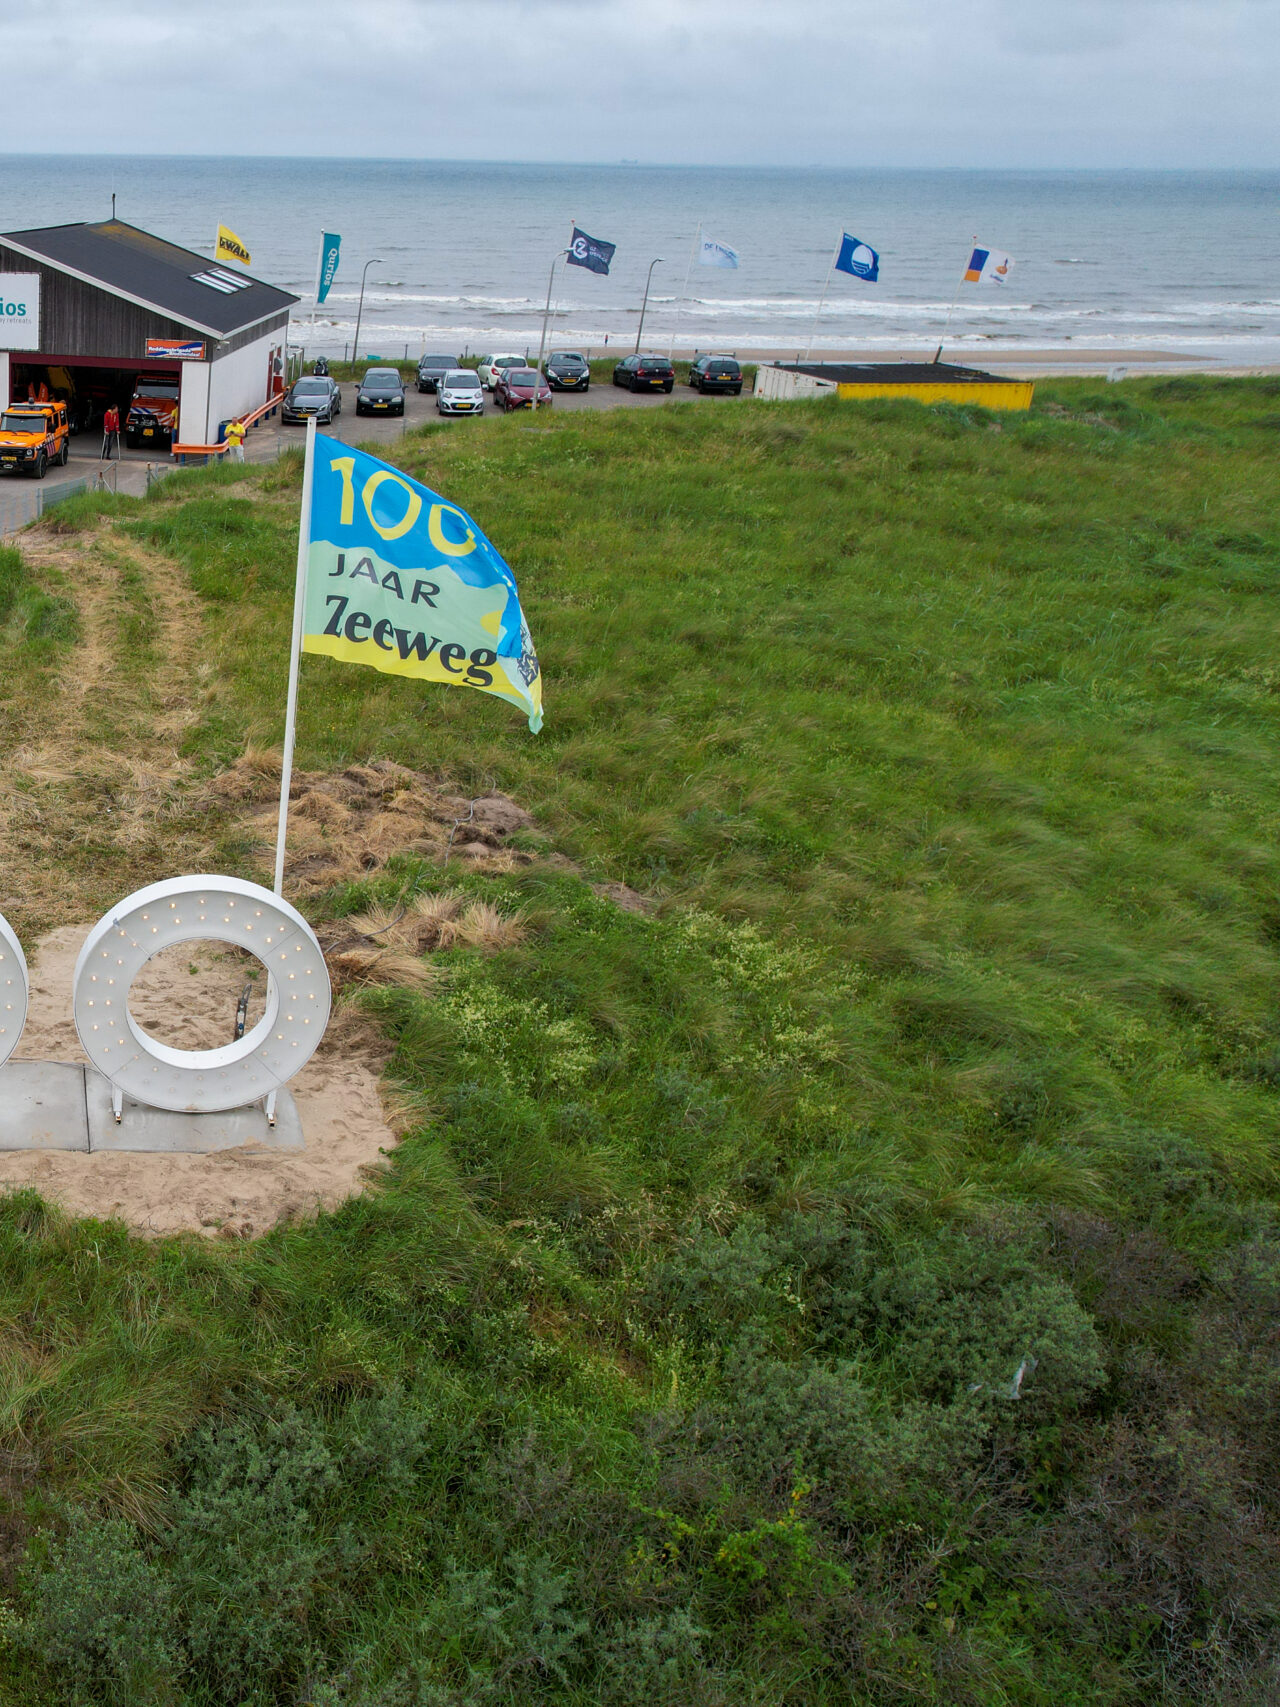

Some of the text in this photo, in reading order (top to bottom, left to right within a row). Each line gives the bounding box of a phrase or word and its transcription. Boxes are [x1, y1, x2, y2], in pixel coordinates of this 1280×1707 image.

[324, 247, 338, 286] Qurios
[330, 457, 477, 557] 100
[328, 554, 441, 608] JAAR
[323, 595, 498, 687] Zeeweg
